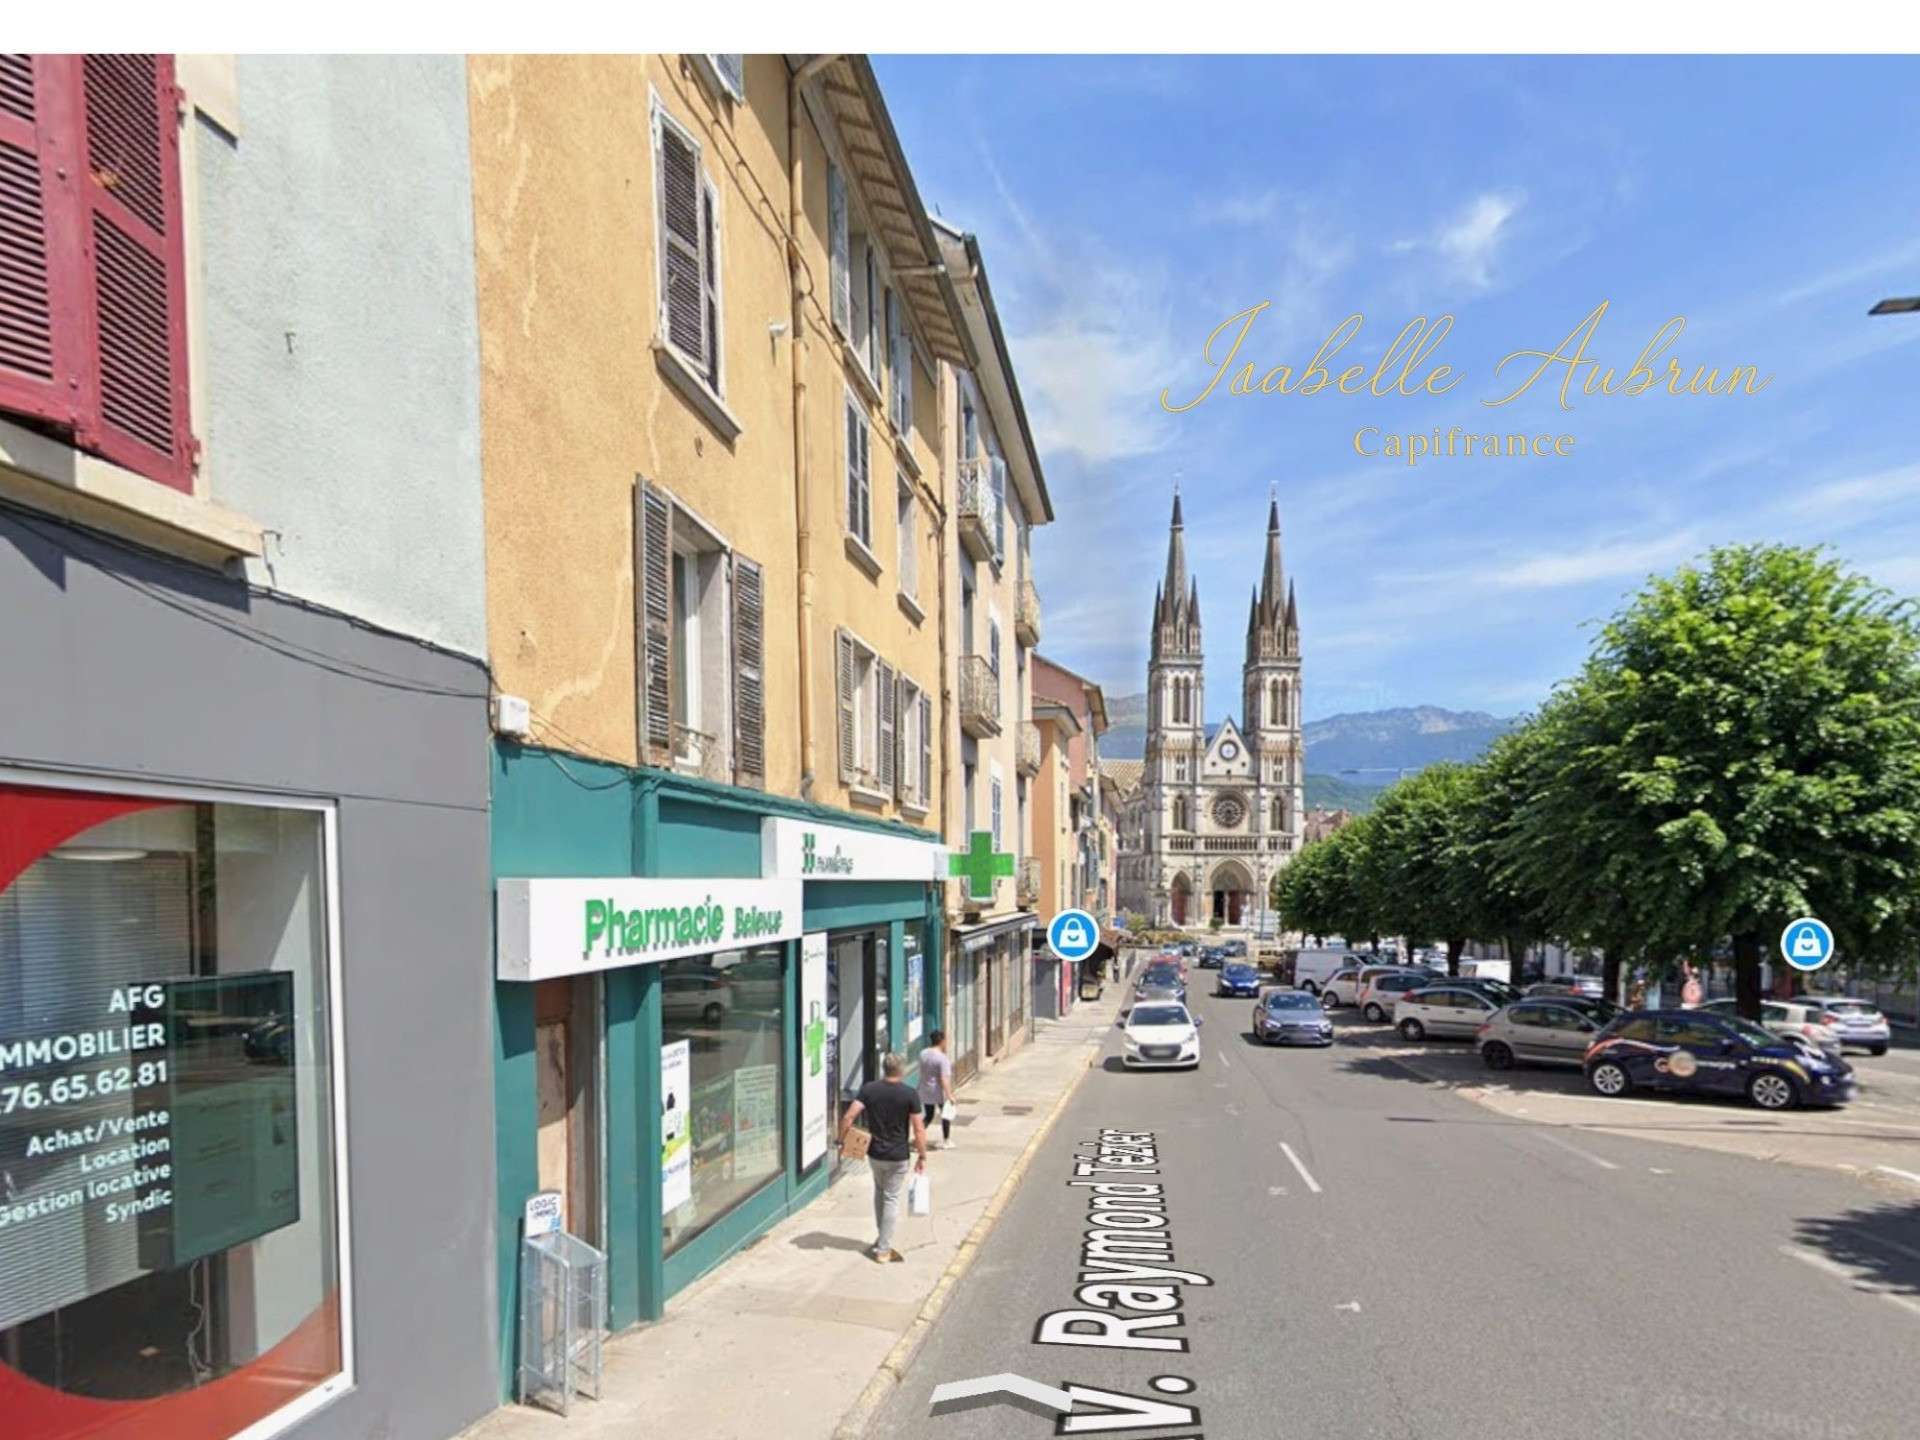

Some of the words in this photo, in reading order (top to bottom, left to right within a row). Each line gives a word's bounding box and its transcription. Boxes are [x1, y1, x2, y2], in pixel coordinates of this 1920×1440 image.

[584, 894, 724, 956] Pharmacie
[108, 984, 166, 1013] AFG
[0, 1060, 167, 1115] 76.65.62.81
[26, 1110, 169, 1157] Achat/Vente
[81, 1137, 170, 1172] Location
[0, 1189, 84, 1227] Gestion
[87, 1164, 171, 1199] locative
[106, 1189, 172, 1223] Syndic
